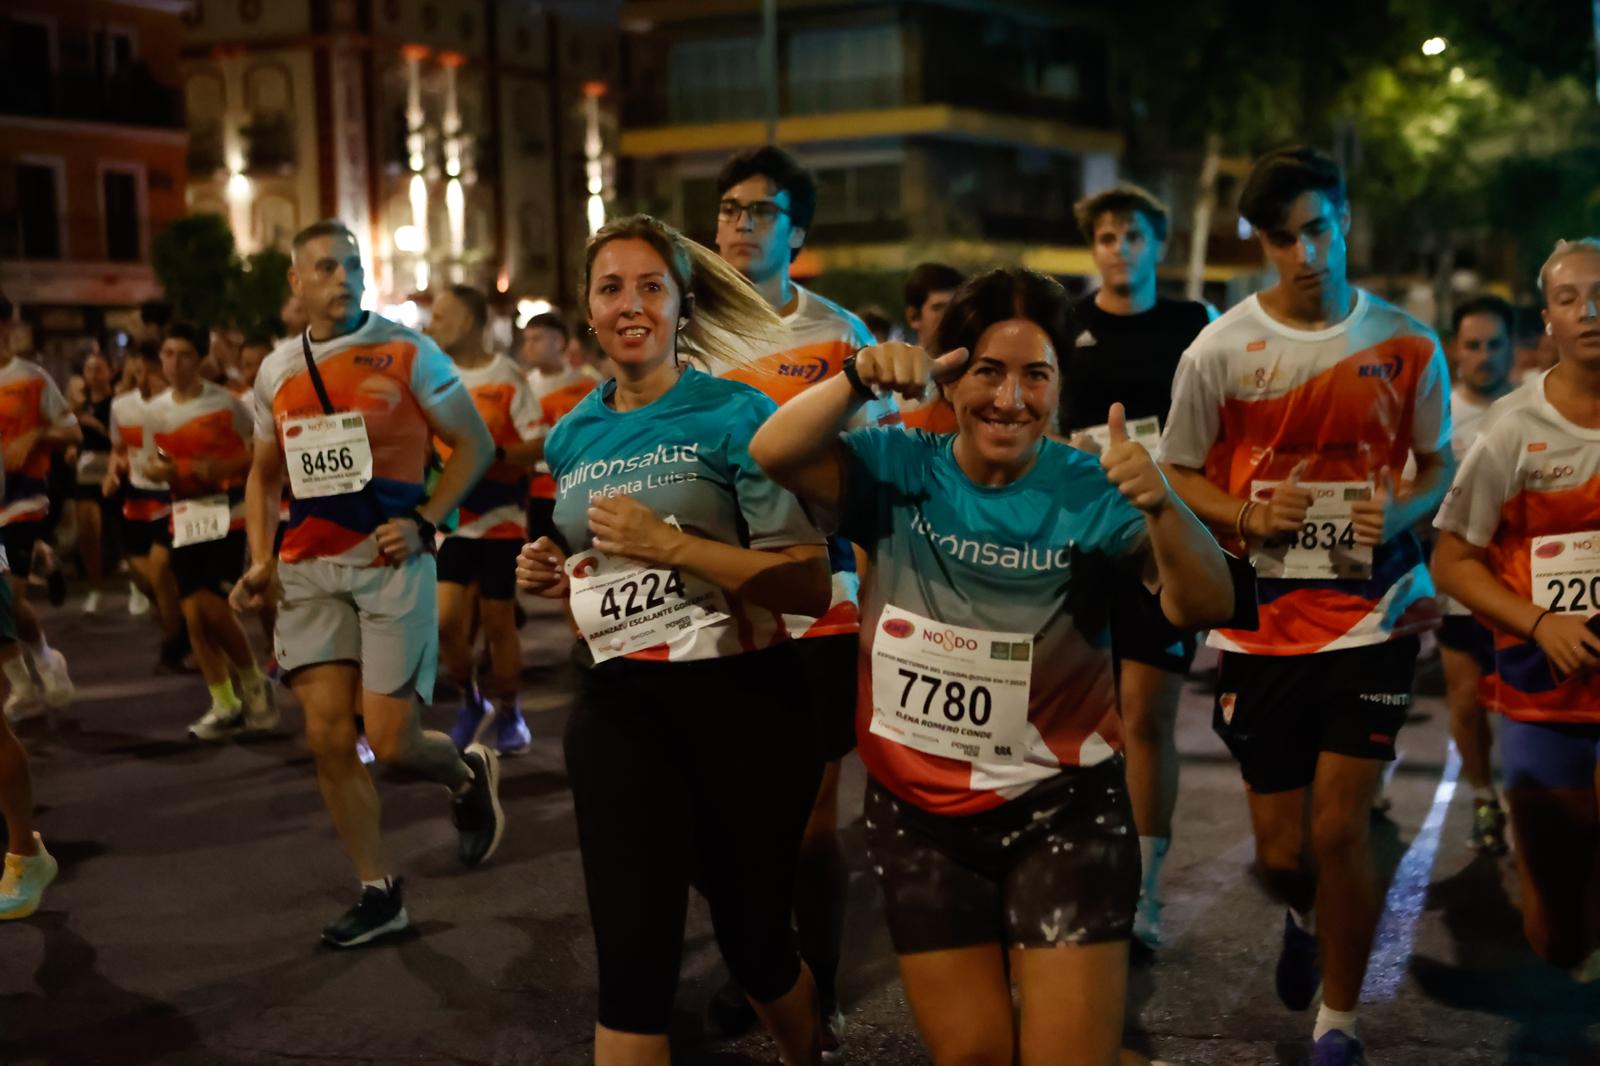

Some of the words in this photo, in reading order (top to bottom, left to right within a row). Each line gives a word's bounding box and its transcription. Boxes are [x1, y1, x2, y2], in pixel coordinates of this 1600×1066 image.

[301, 446, 354, 475] 8456
[588, 480, 642, 503] Infanta
[647, 471, 697, 489] Luisa
[601, 569, 685, 620] 4224
[629, 606, 673, 627] ESCALANTE
[898, 668, 992, 726] 7780
[896, 710, 920, 725] ELENA
[921, 719, 960, 734] ROMERO
[961, 728, 992, 740] CONDE
